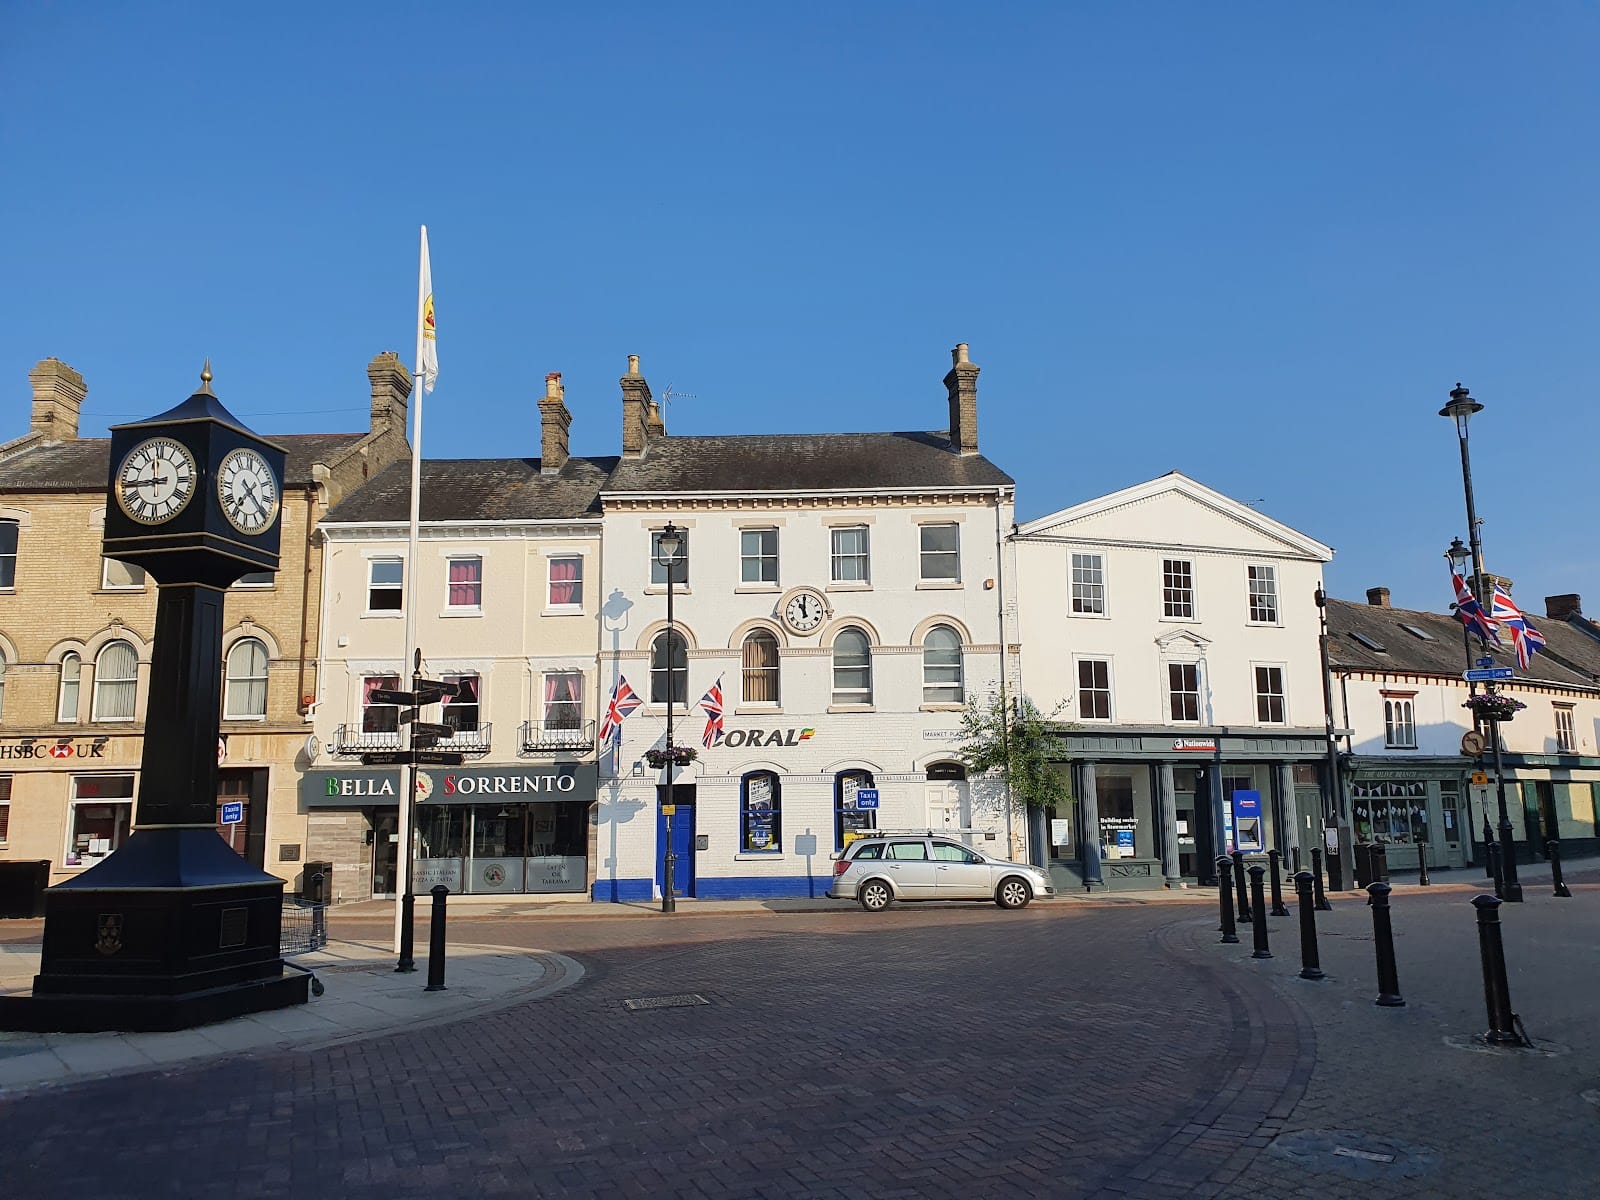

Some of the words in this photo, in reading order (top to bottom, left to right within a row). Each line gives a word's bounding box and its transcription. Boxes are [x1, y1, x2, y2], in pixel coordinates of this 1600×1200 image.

[1183, 739, 1215, 747] Nationwide
[0, 744, 47, 759] HSBC
[76, 744, 105, 758] UK
[326, 777, 395, 796] BELLA
[443, 774, 576, 796] SORRENTO
[860, 791, 877, 799] Taxis
[225, 813, 238, 821] only
